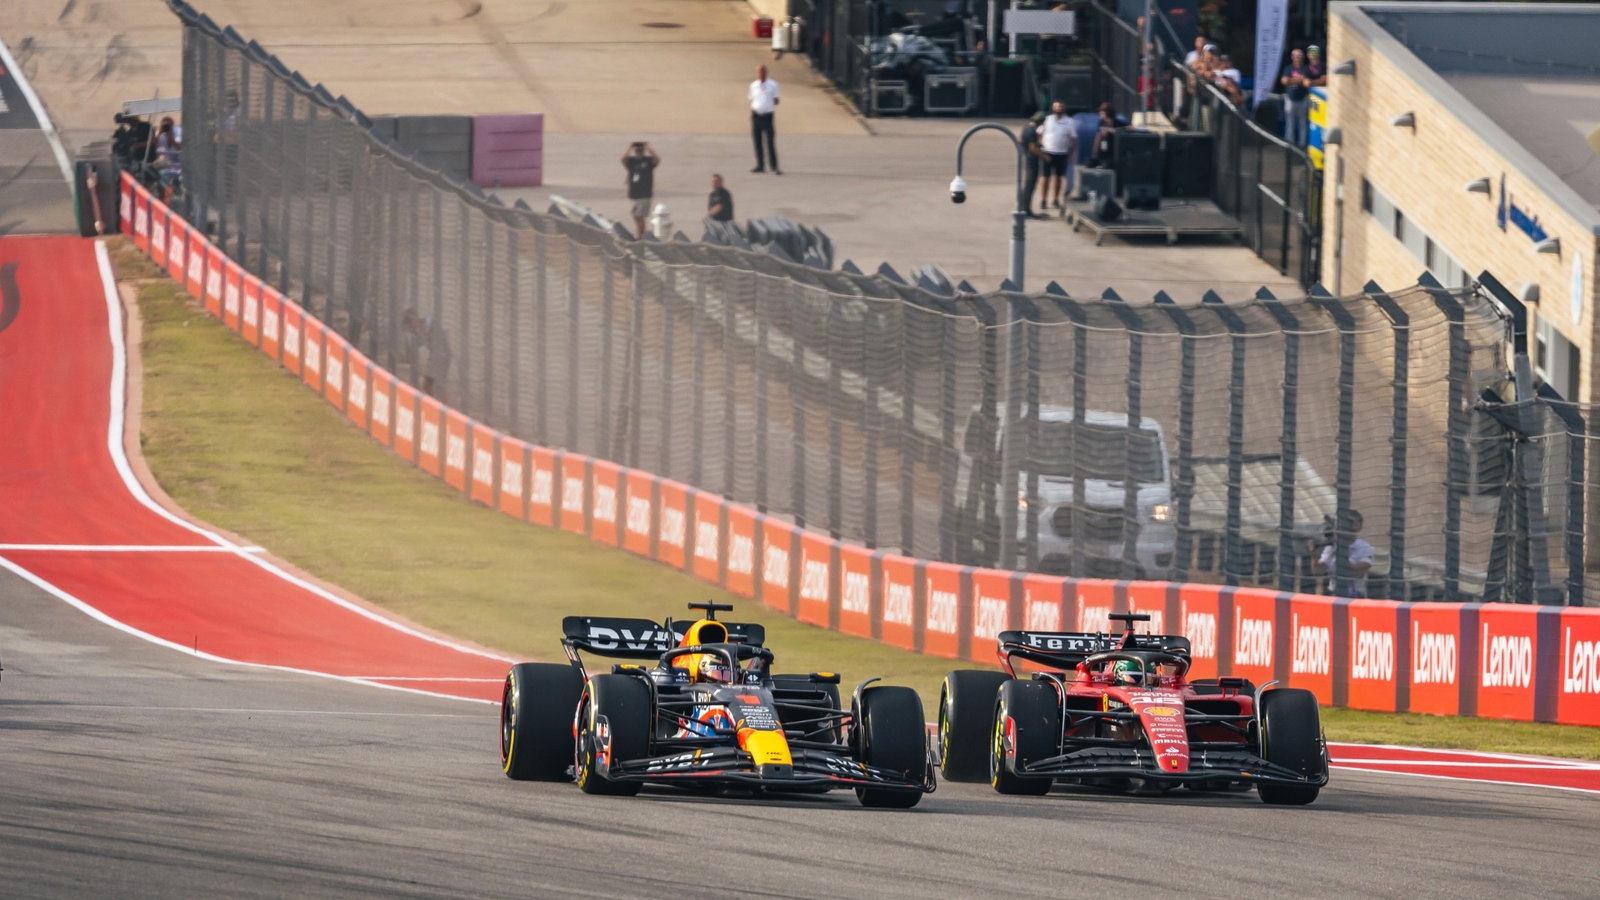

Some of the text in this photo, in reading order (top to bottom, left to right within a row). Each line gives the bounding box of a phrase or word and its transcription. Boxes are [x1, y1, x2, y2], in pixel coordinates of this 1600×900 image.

[1235, 606, 1272, 667] Lenovo
[1293, 612, 1330, 675] Lenovo
[1352, 616, 1393, 681] Lenovo
[1413, 620, 1457, 685] Lenovo
[1482, 622, 1532, 689] Lenovo
